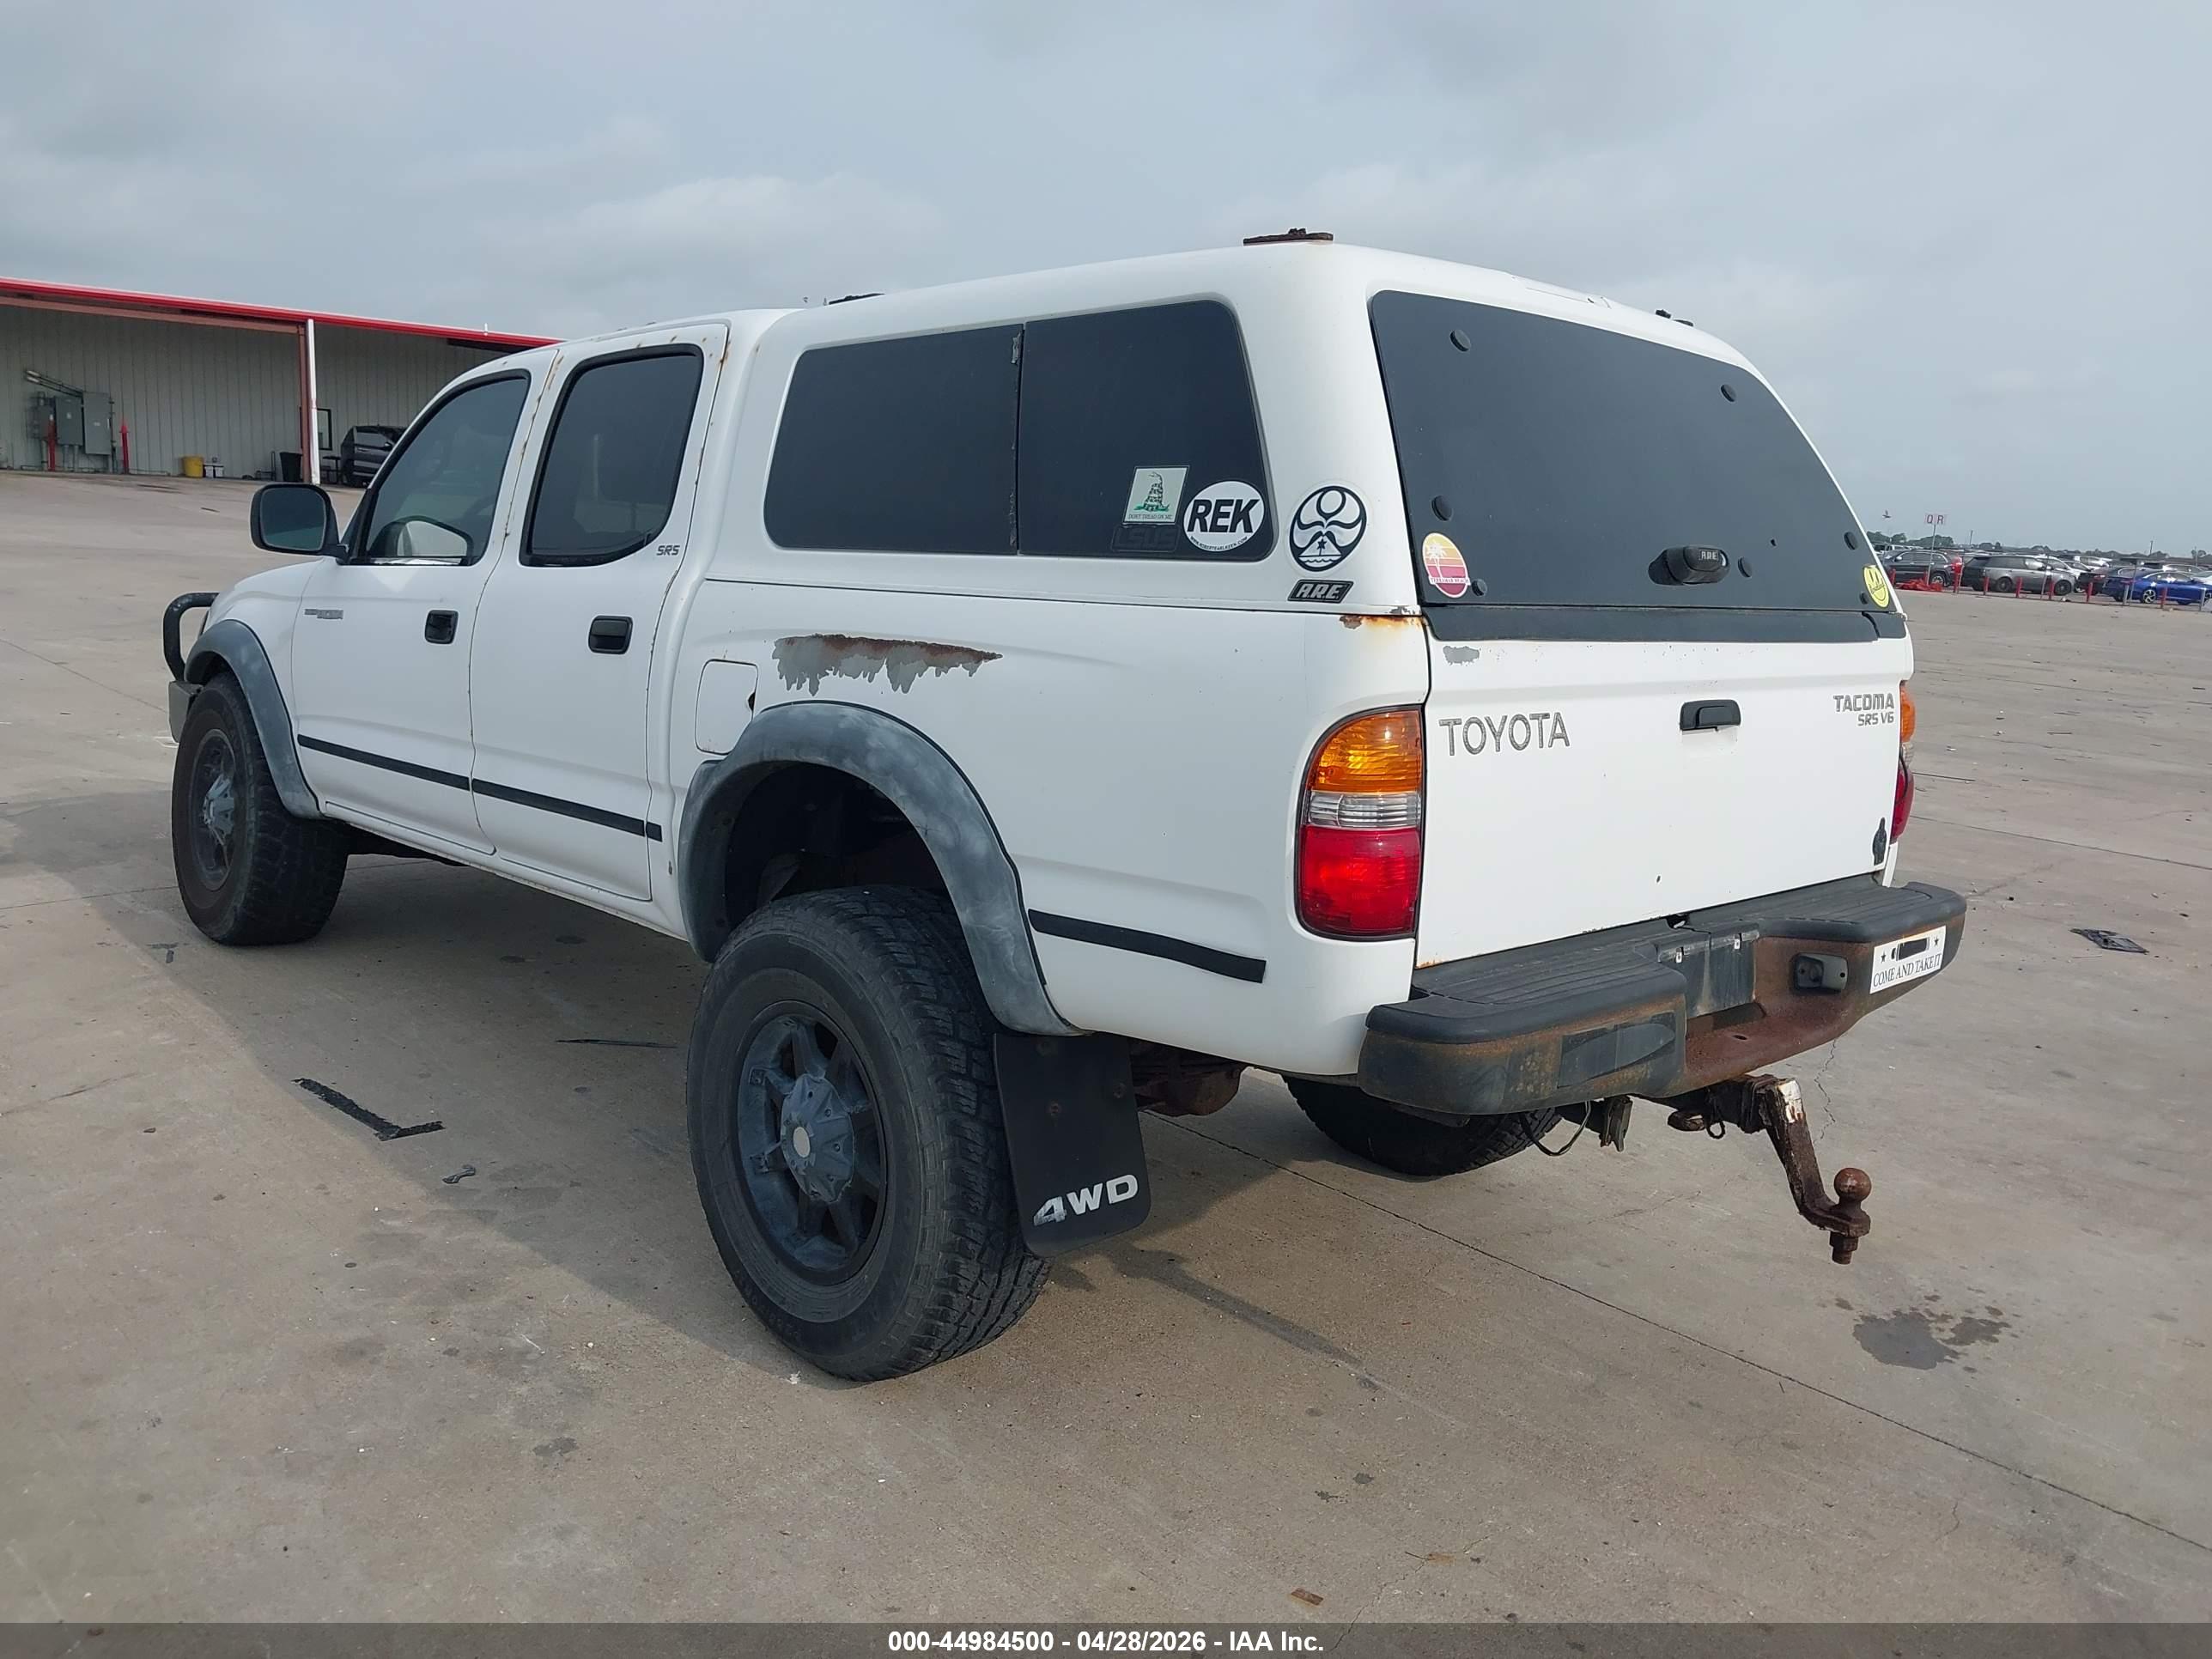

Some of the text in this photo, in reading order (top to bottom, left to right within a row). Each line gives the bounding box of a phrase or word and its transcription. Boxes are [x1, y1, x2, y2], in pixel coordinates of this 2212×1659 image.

[1187, 499, 1260, 532] REK
[1937, 514, 1944, 525] R
[1833, 693, 1894, 712] TACOMA
[1881, 711, 1894, 724] V6
[1438, 712, 1570, 756] TOYOTA
[1873, 952, 1942, 987] COME AND TAKE IT
[1033, 1174, 1139, 1226] 4WD
